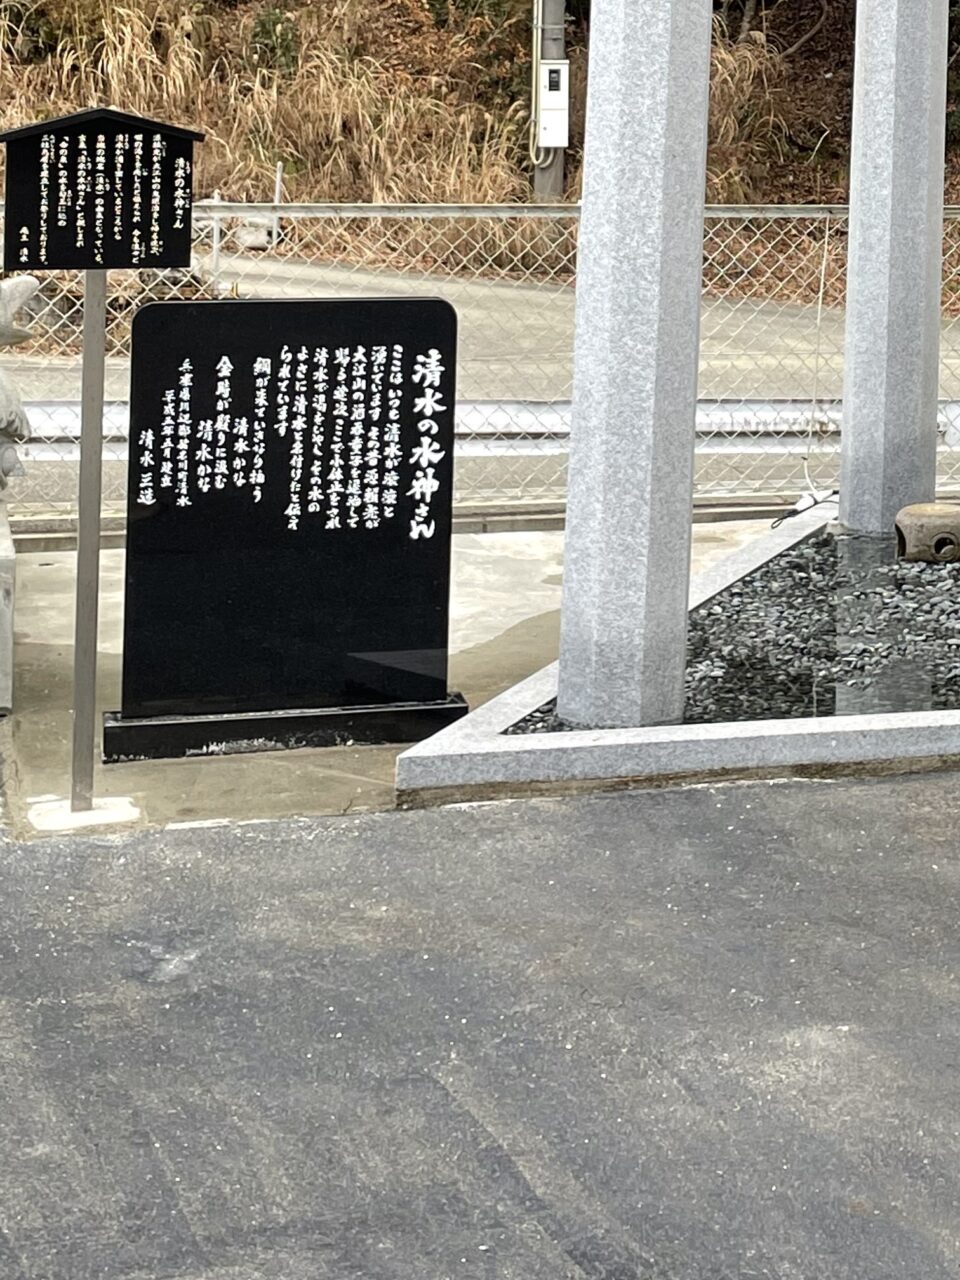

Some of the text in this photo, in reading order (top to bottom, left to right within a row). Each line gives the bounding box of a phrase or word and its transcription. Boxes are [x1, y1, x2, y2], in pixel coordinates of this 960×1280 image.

[274, 344, 293, 438] られています
[195, 419, 214, 494] 清水かな
[232, 416, 251, 488] 清水かな
[405, 348, 447, 541] 清水の水神さん
